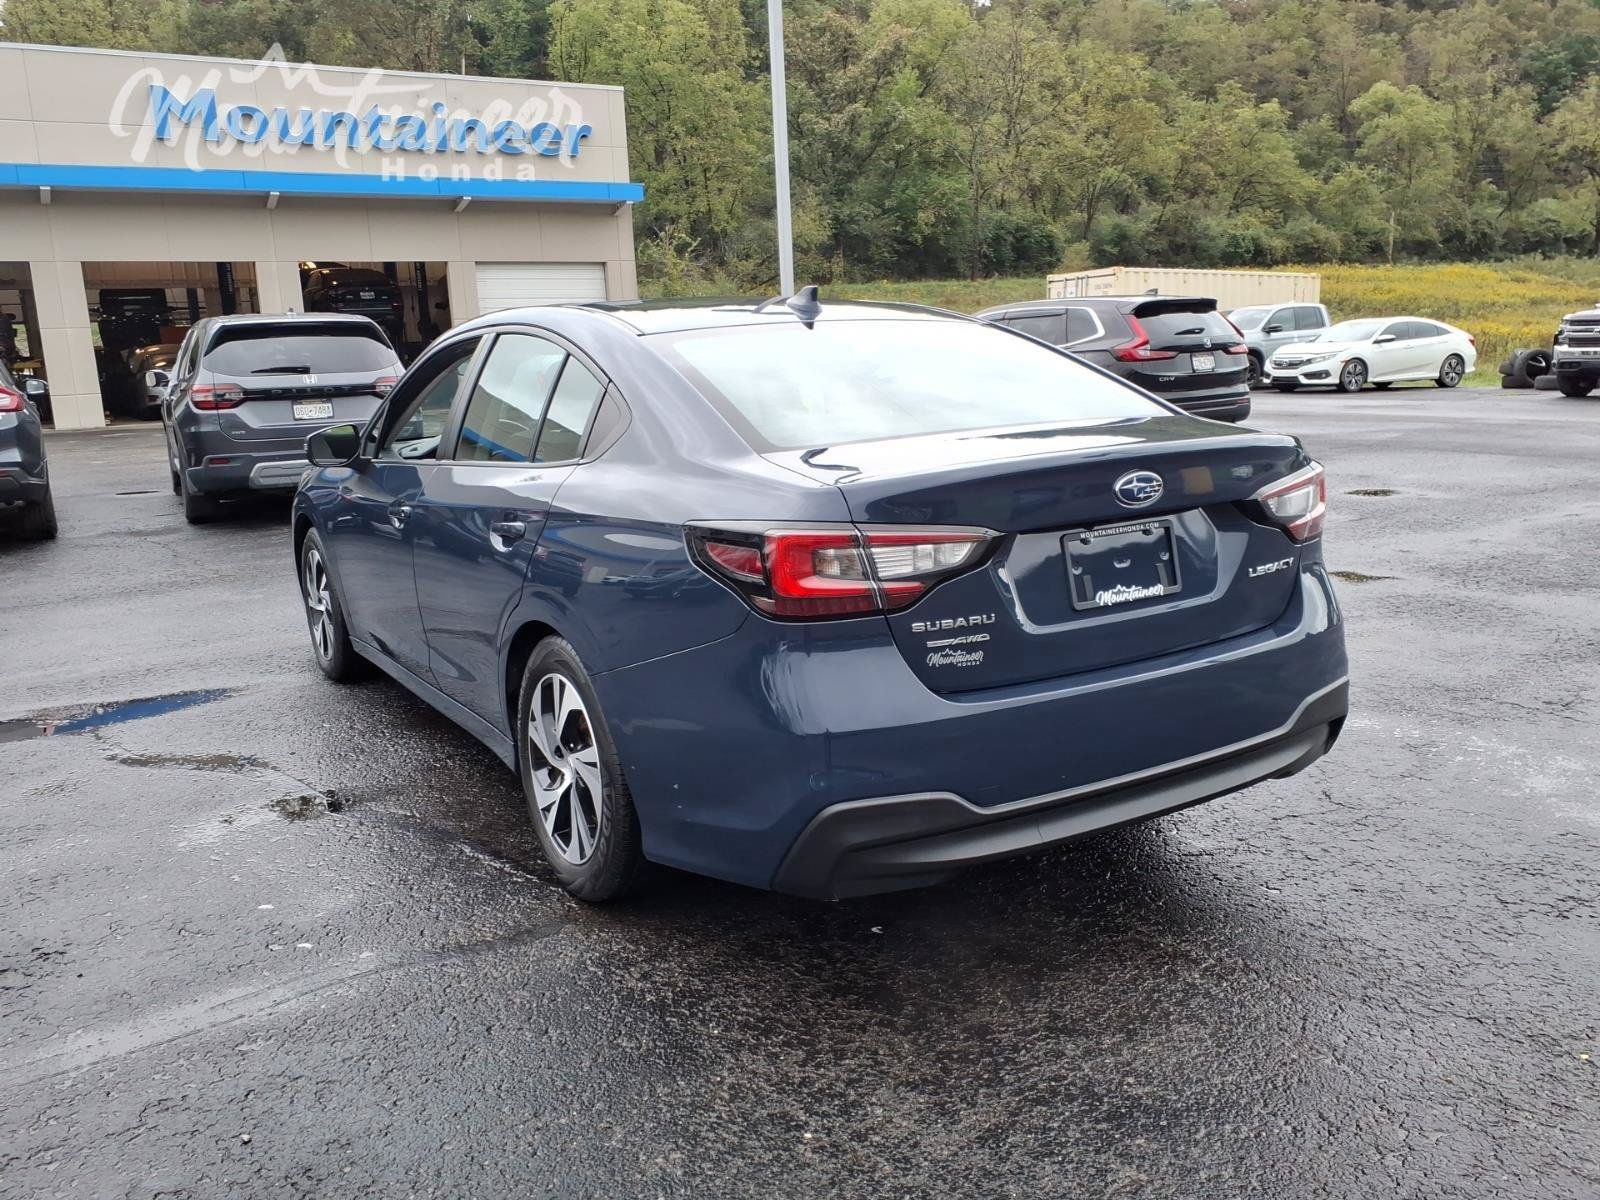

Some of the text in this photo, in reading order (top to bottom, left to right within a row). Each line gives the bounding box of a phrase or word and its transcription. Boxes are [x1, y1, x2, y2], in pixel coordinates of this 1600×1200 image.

[150, 83, 593, 157] Mountaineer
[1080, 522, 1160, 539] MOUNTAINEERHONDA.COM
[1248, 557, 1294, 578] LEGACY
[1095, 584, 1164, 606] Mountaineer
[911, 613, 996, 633] SUBARU
[952, 633, 991, 646] AWD
[926, 648, 984, 667] Mountaineer
